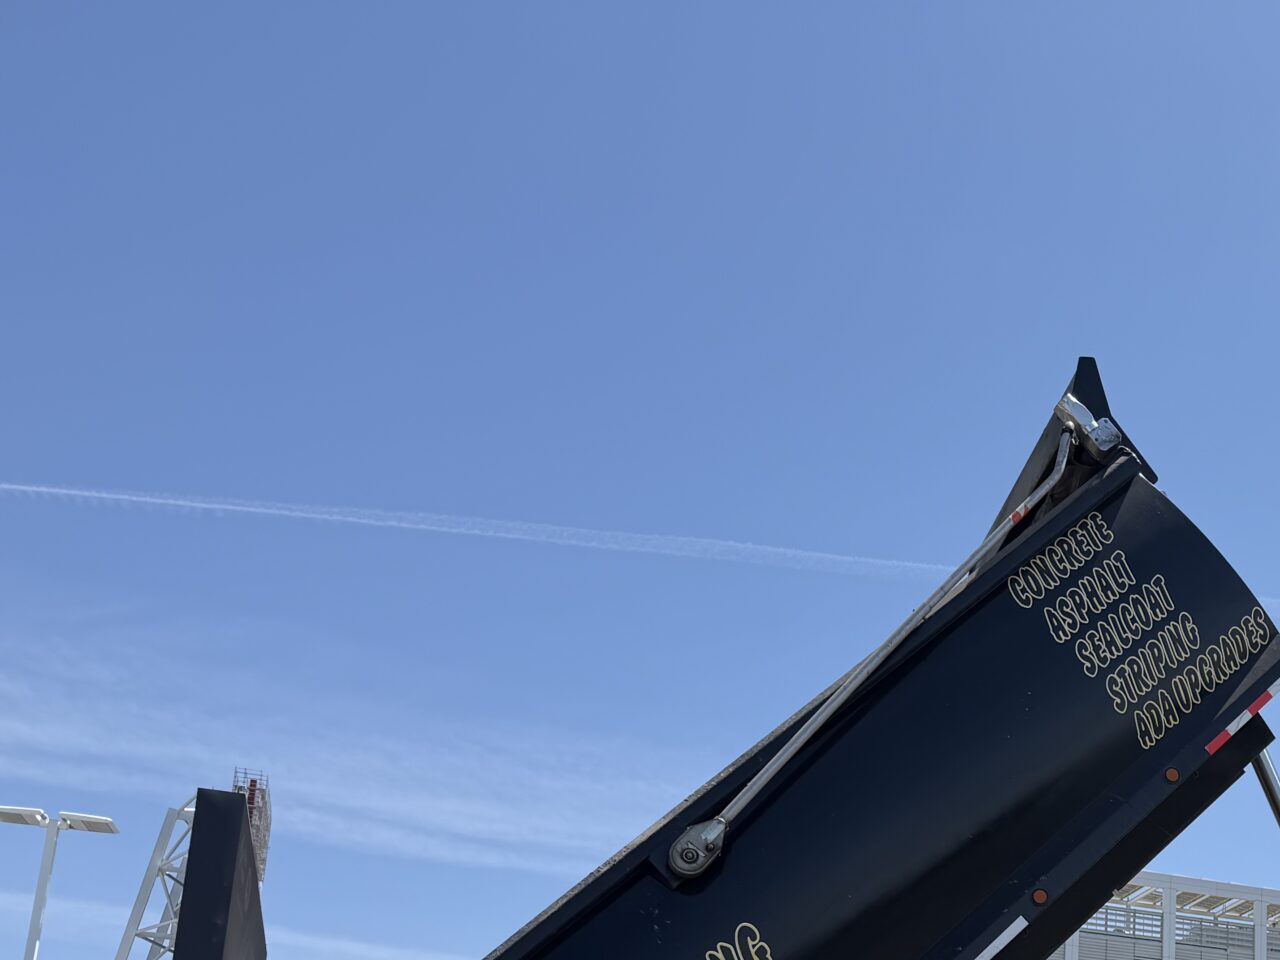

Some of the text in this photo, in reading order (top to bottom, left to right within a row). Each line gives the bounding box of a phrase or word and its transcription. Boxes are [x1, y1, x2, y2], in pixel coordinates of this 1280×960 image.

[1008, 511, 1114, 608] CONCRETE
[1044, 550, 1136, 643] ASPHALT
[1075, 574, 1175, 678] SEALCOAT
[1105, 611, 1200, 714] STRIPING
[1134, 606, 1270, 750] ADA UPGRADES
